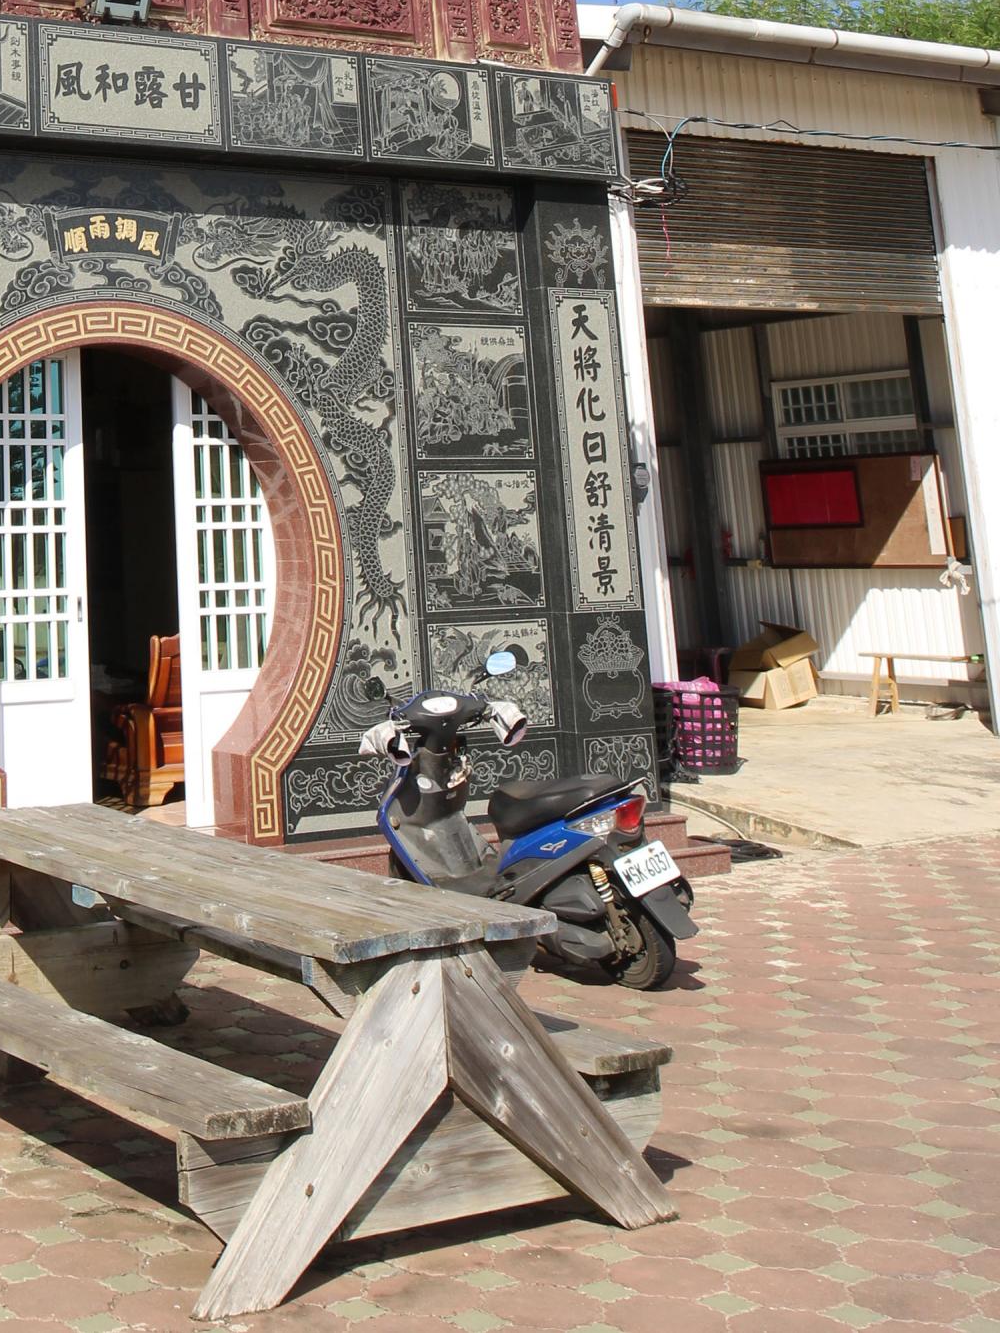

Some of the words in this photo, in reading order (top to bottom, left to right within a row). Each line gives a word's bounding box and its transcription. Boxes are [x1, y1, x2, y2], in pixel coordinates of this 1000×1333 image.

[54, 61, 206, 111] 甘露和風
[63, 215, 161, 256] 風調雨順
[570, 304, 616, 596] 天將化日舒清景
[621, 851, 672, 887] MSK-6037
